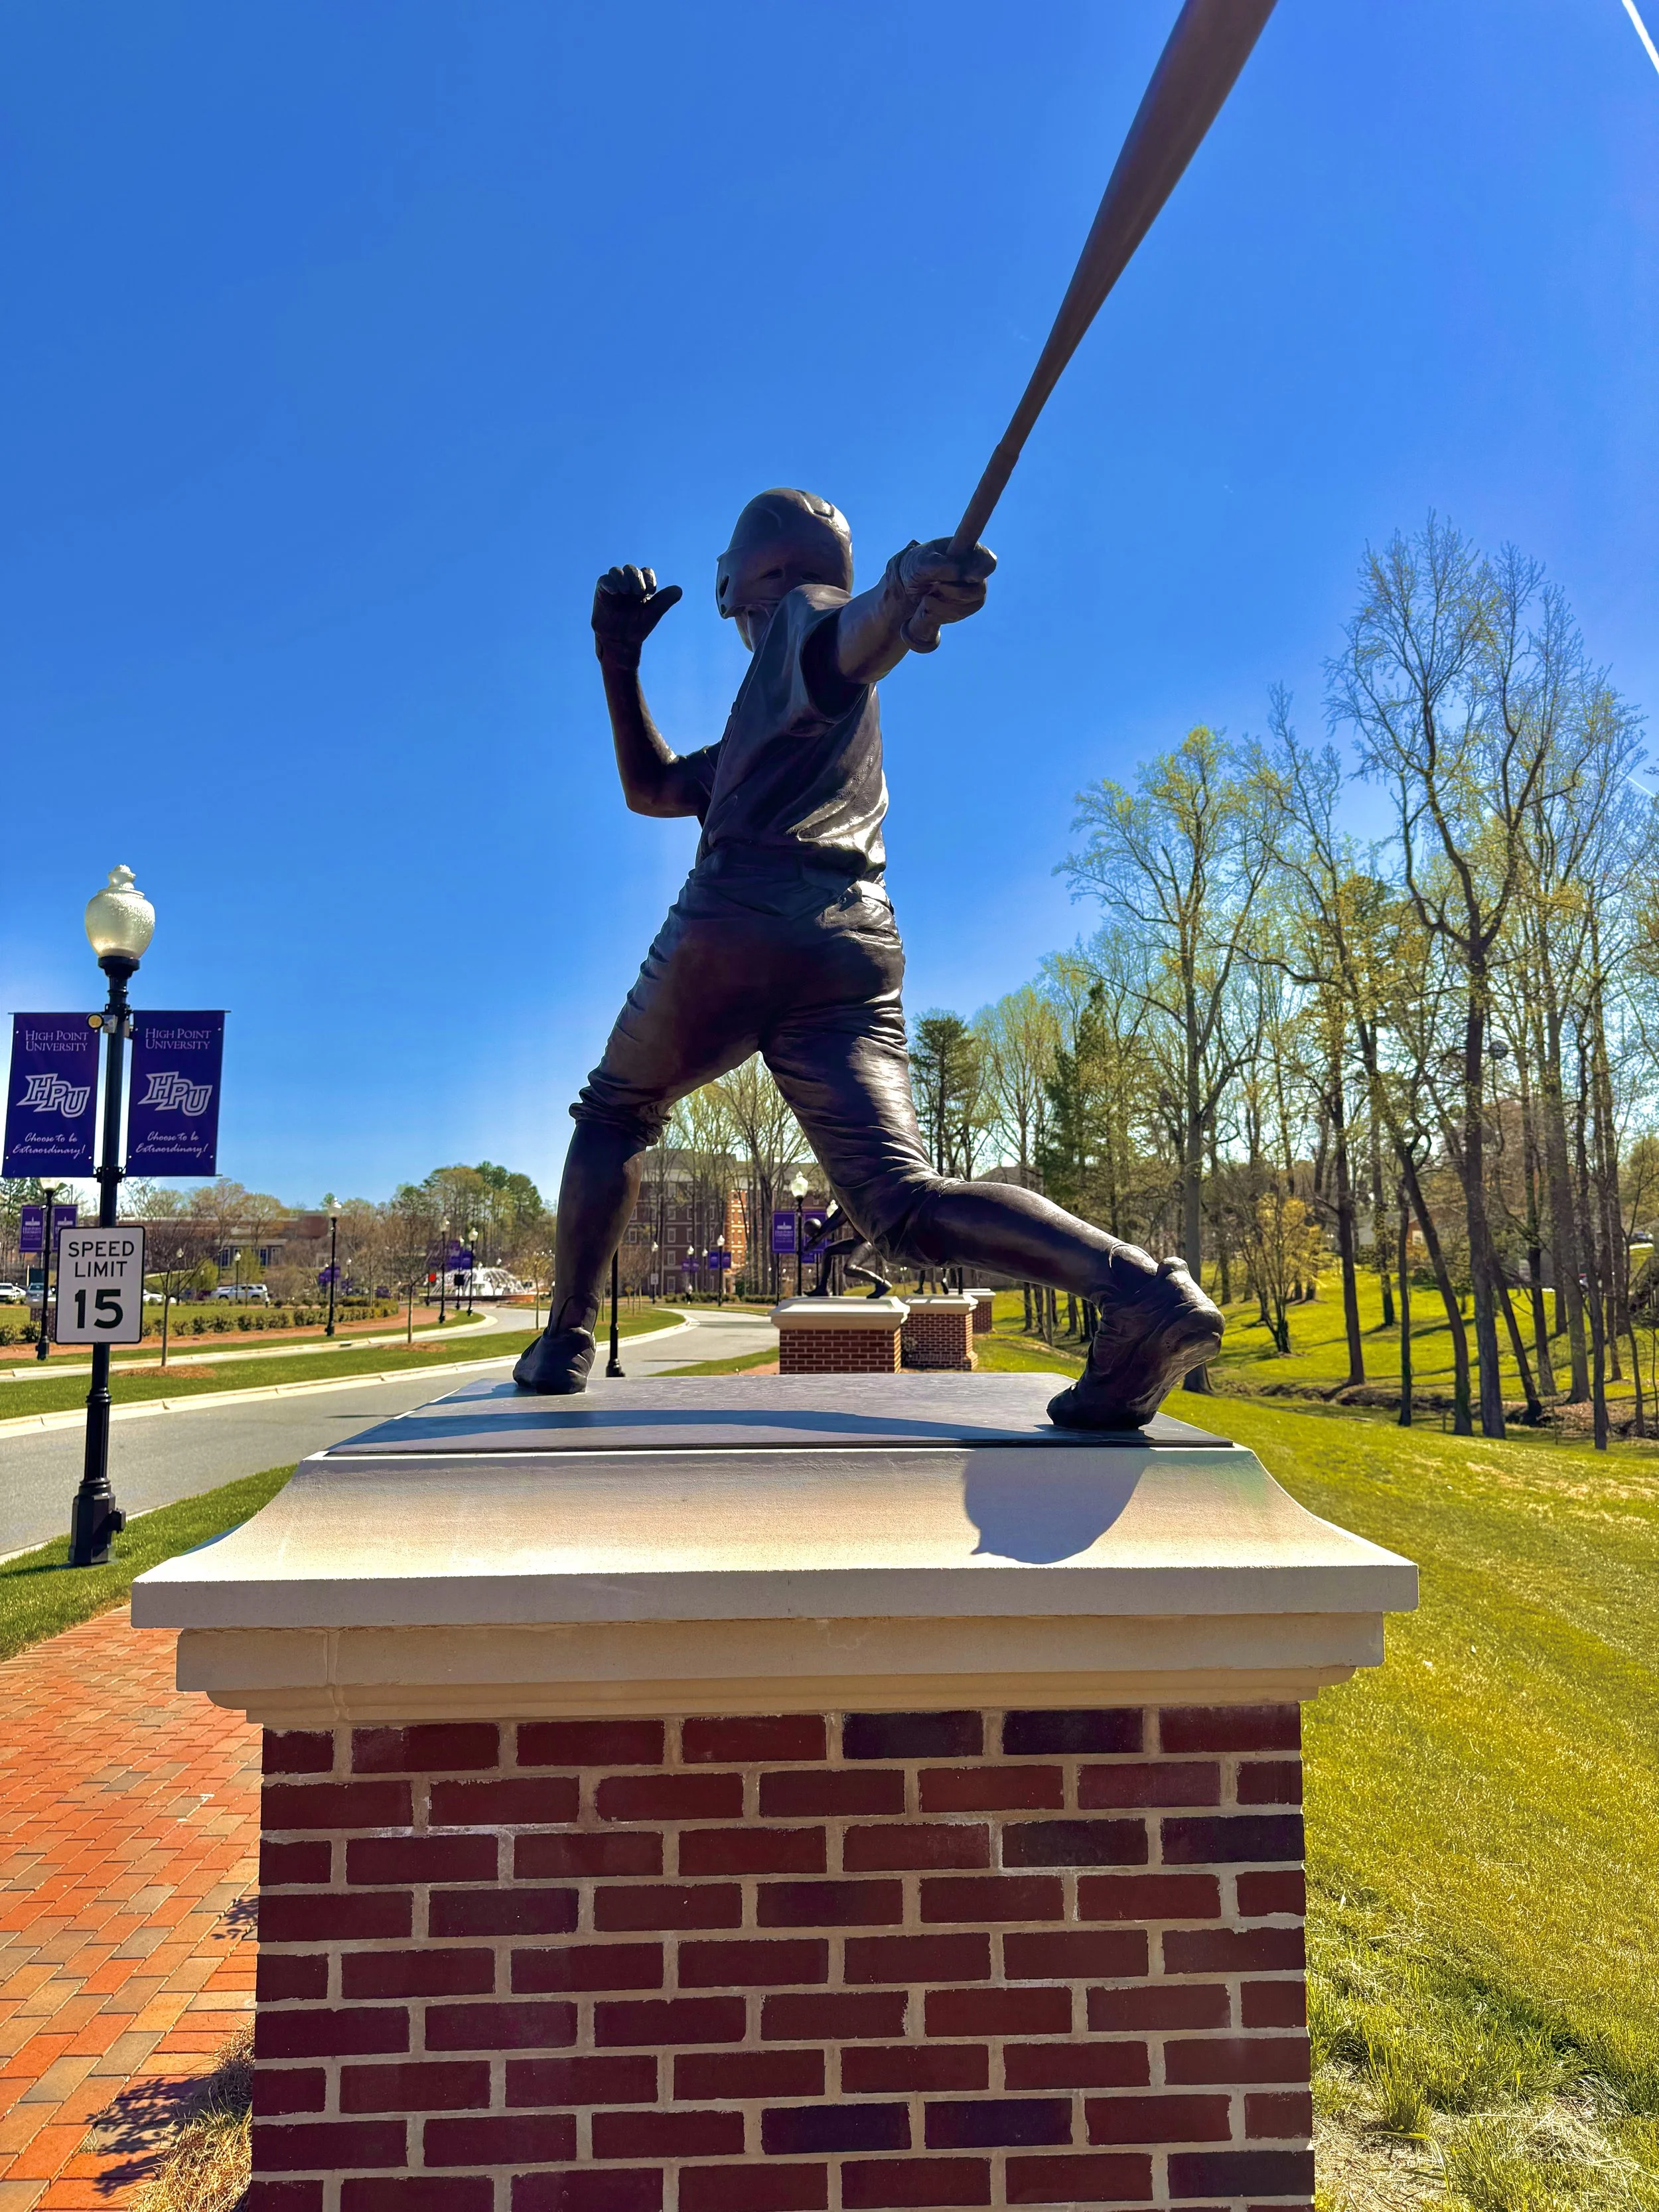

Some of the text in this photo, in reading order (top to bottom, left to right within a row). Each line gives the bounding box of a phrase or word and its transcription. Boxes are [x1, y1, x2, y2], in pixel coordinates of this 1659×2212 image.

[25, 1030, 89, 1041] HIGH POINT
[145, 1028, 212, 1039] HIGH POINT
[25, 1041, 88, 1052] UNIVERSITY
[145, 1039, 211, 1050] UNIVERSITY
[16, 1072, 92, 1118] HPU
[137, 1071, 213, 1117] HPU
[25, 1132, 78, 1142] Choose to be
[147, 1131, 199, 1141] Choose to be
[12, 1143, 86, 1159] Extraordinary!
[135, 1143, 209, 1158] Extraordinary!
[68, 1240, 135, 1258] SPEED
[74, 1261, 128, 1278] LIMIT
[74, 1288, 124, 1329] 15
